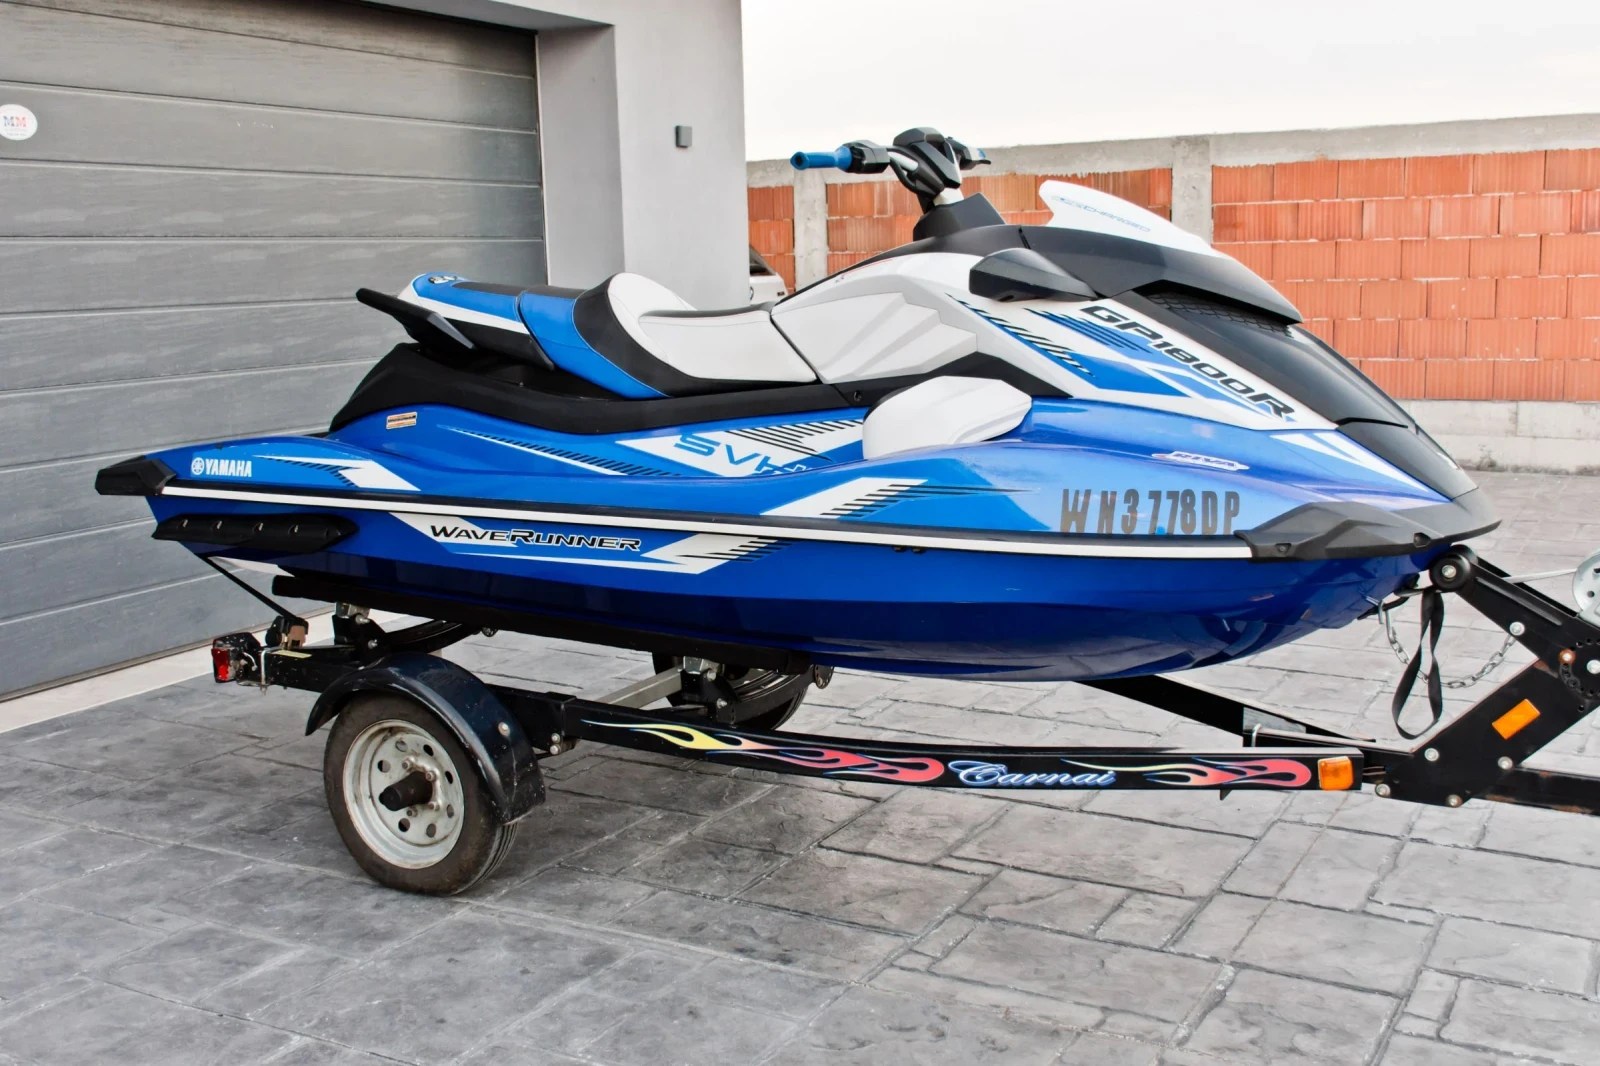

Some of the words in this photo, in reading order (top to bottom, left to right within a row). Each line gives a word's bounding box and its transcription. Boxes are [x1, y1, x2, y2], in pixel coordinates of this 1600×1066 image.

[1080, 305, 1295, 419] GP1800R
[205, 458, 252, 477] YAMAHA
[430, 525, 641, 551] WAVERUNNER
[948, 760, 1117, 786] Carnai
